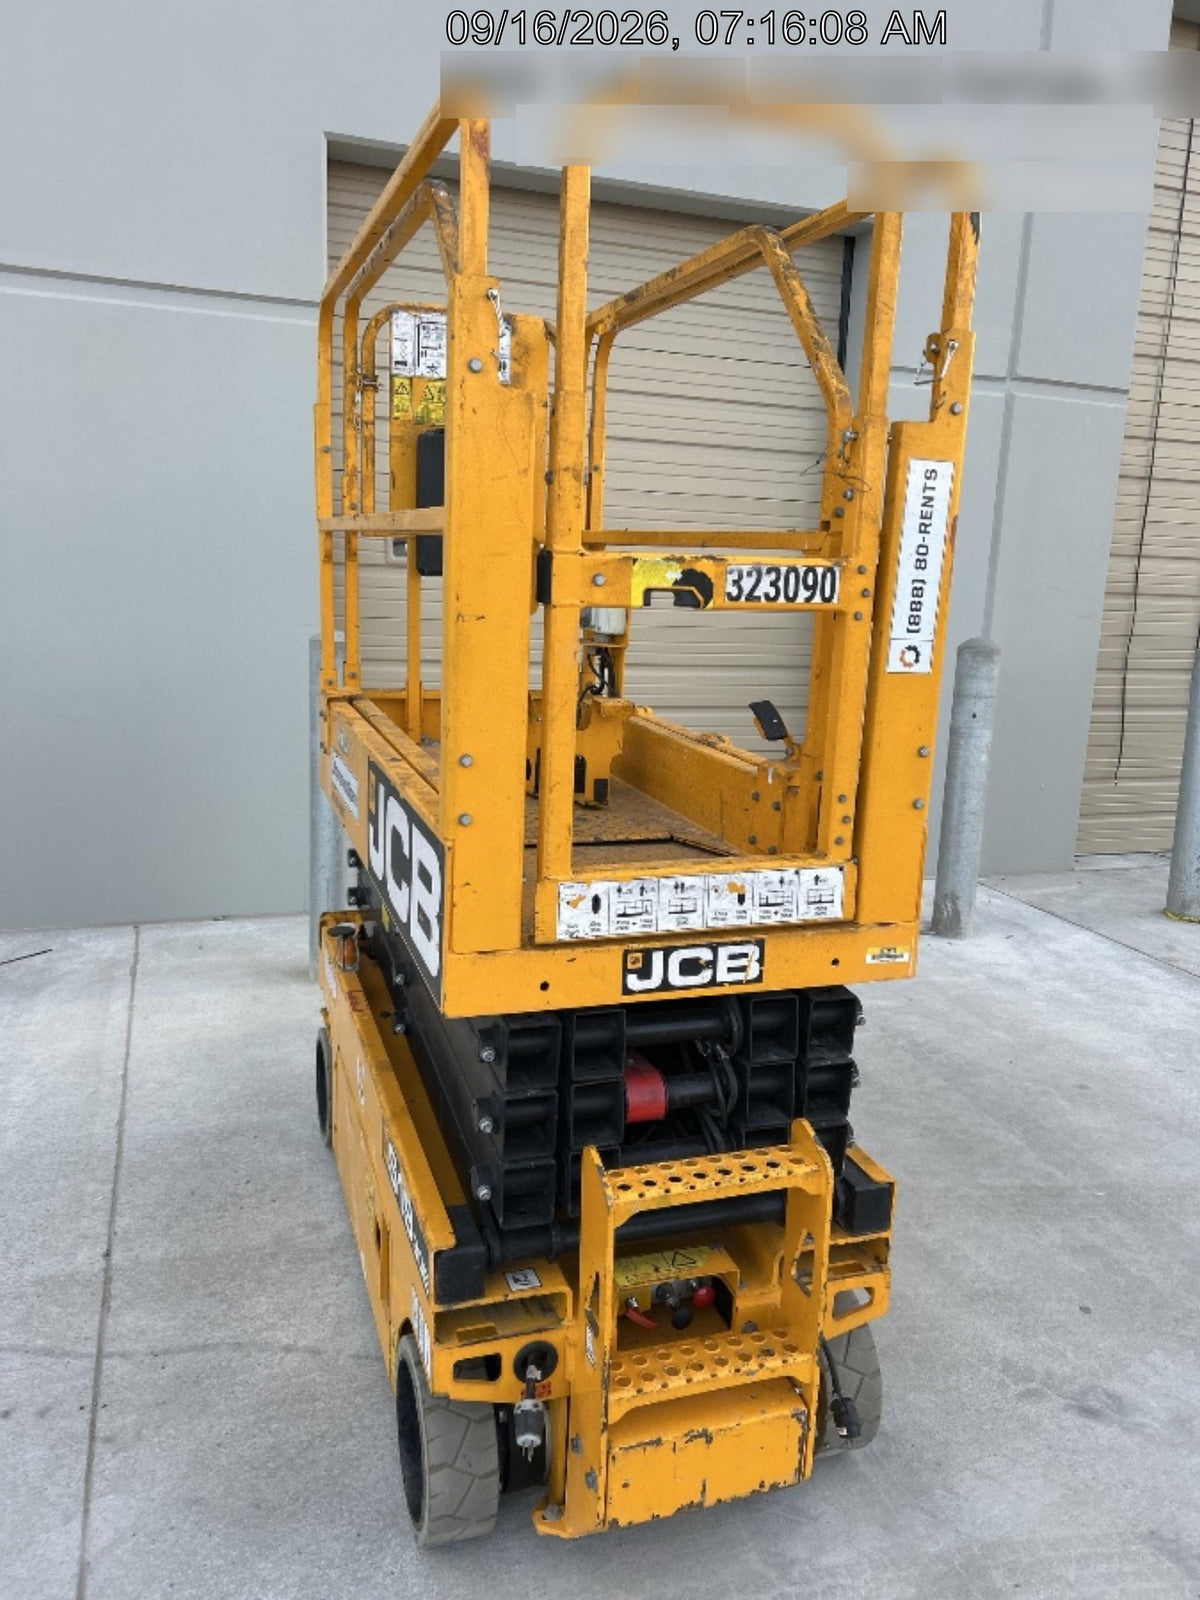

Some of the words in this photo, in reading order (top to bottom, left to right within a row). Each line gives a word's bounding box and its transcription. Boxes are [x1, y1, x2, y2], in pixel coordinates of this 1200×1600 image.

[914, 468, 938, 571] 80-RENTS
[726, 565, 837, 603] 323090
[906, 578, 927, 634] (888)
[369, 783, 441, 977] JCB
[626, 944, 760, 991] JCB
